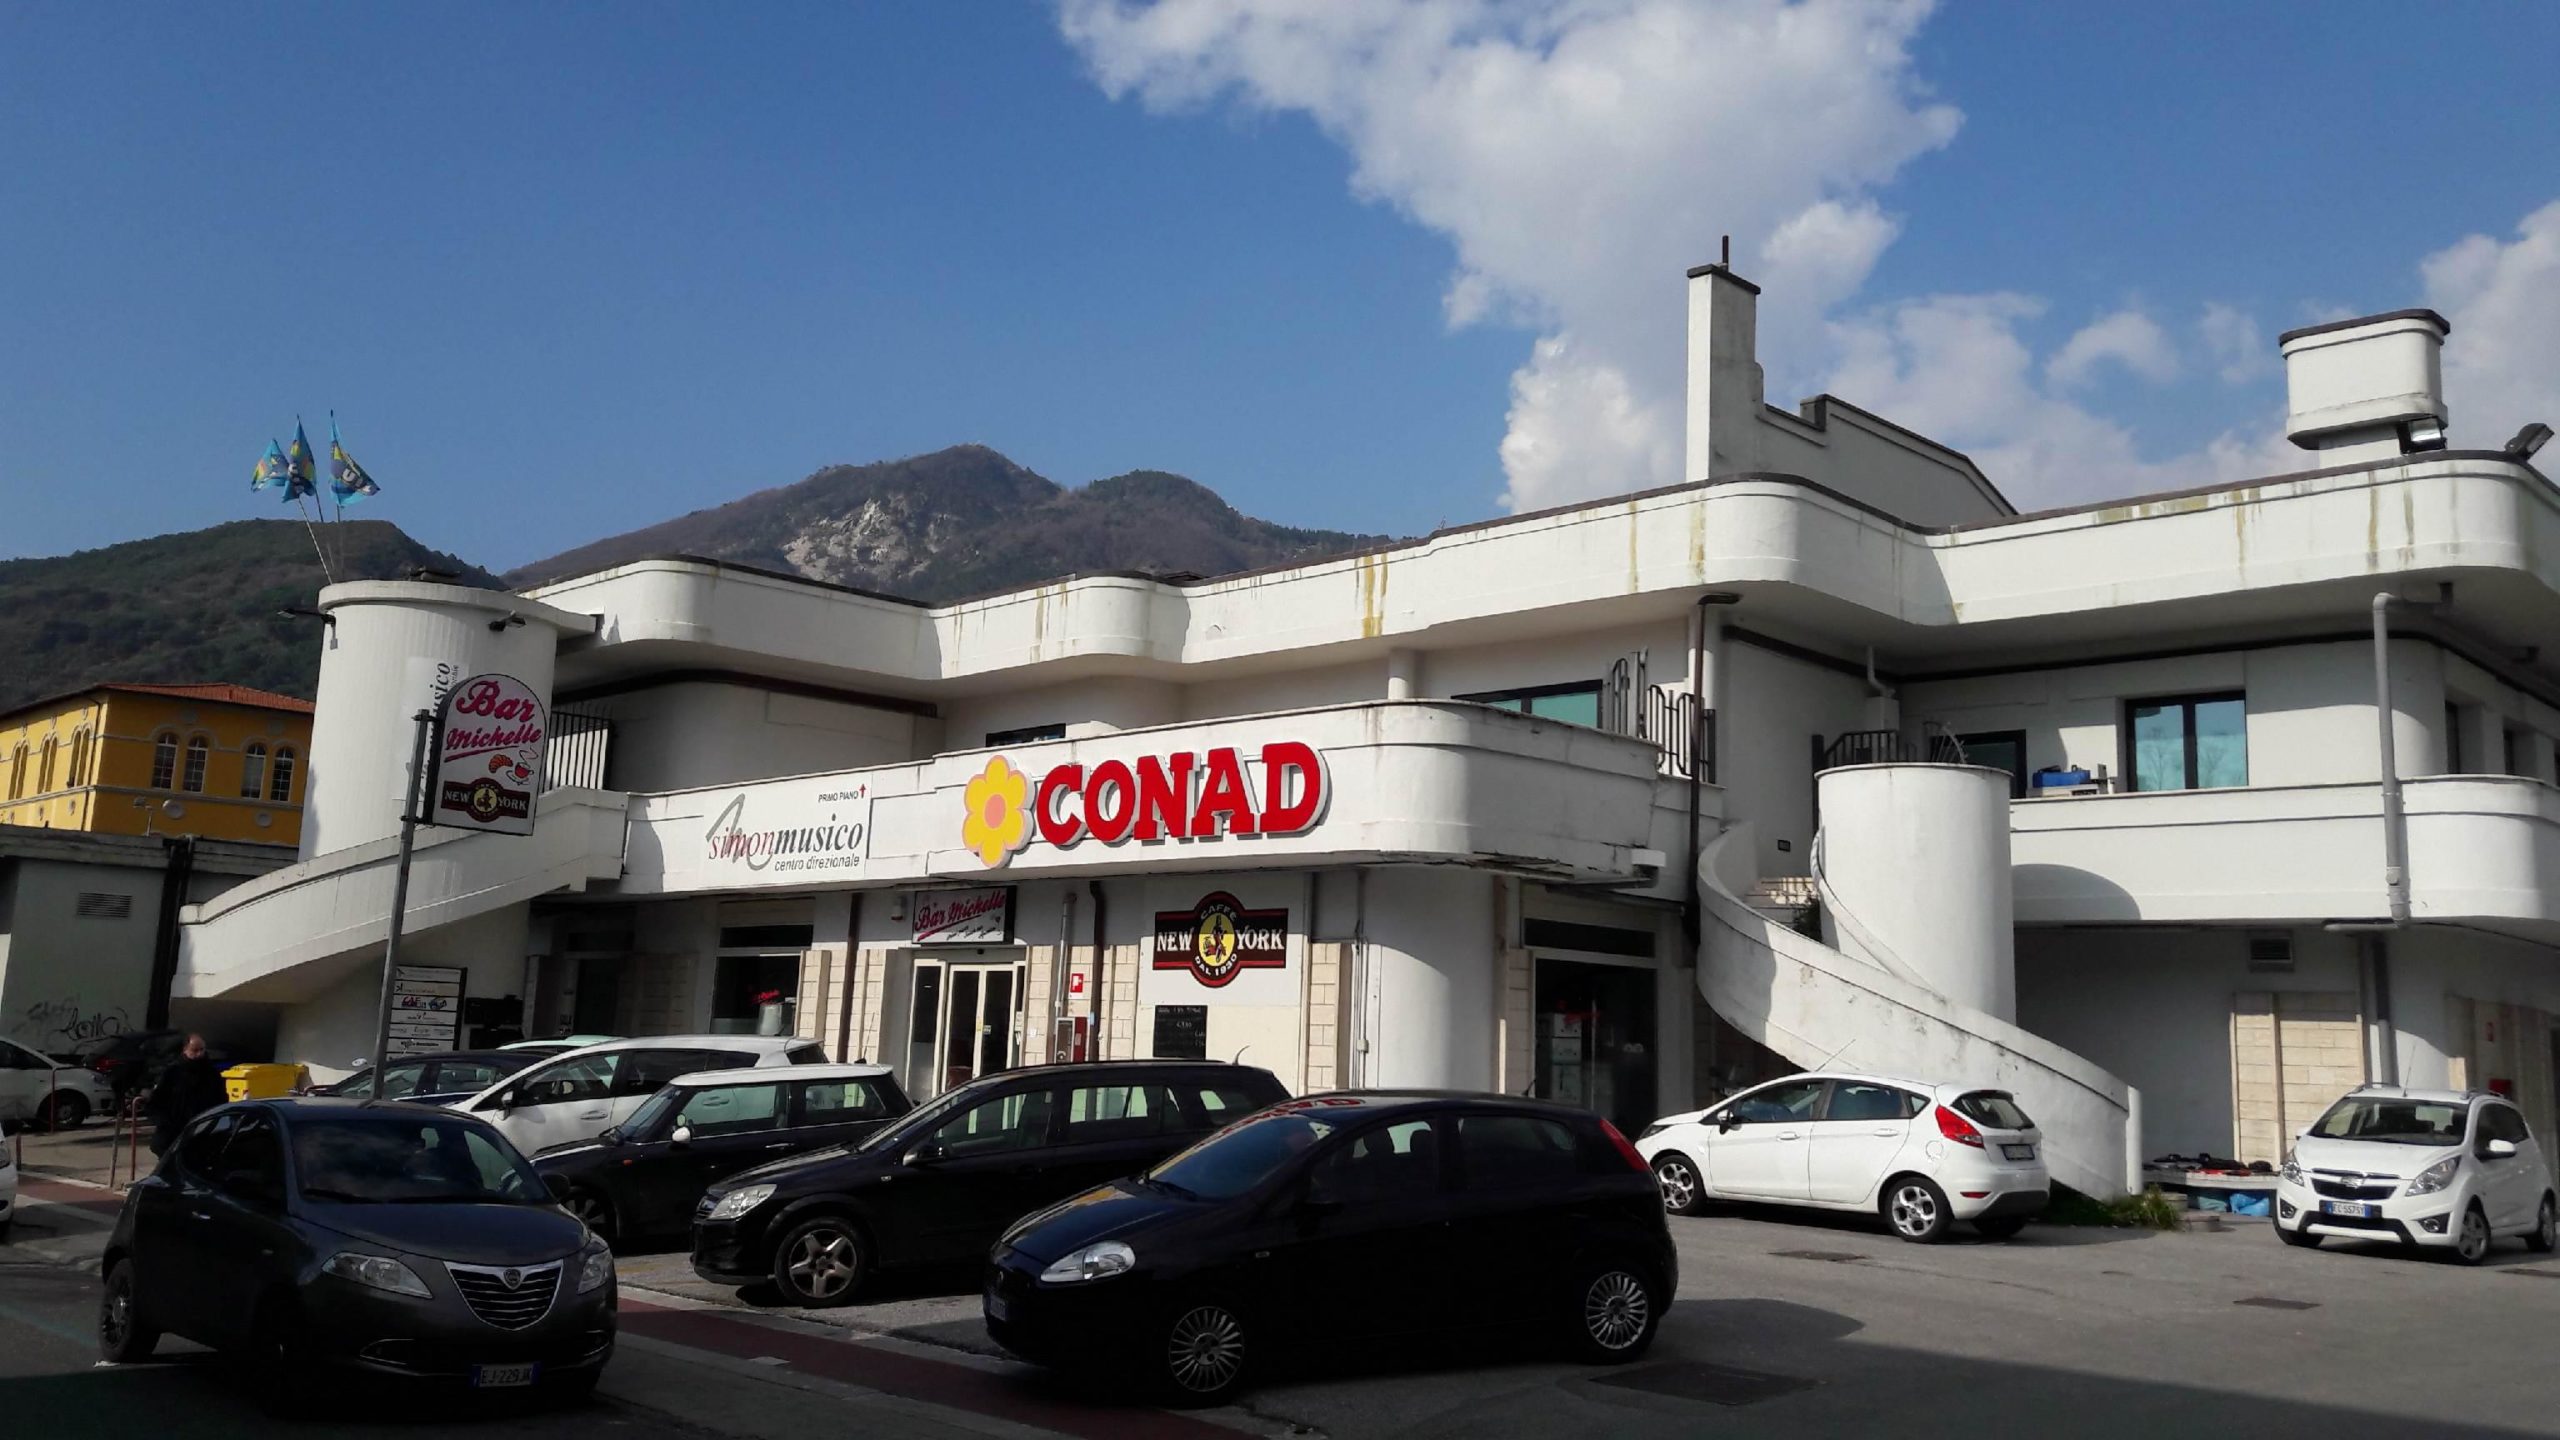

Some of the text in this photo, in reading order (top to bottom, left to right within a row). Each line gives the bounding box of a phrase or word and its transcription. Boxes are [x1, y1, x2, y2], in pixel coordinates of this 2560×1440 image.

[455, 680, 536, 722] Bar
[447, 723, 542, 750] Michelle
[444, 790, 528, 810] NEW YORK
[818, 790, 859, 803] PRIMO PIANO
[1036, 741, 1326, 846] CONAD
[709, 813, 863, 860] simonmusico
[775, 854, 860, 872] centro direzionale
[915, 890, 1006, 931] Bar Michelle
[1157, 925, 1285, 952] NEW YORK
[1195, 953, 1238, 976] DAL 1930
